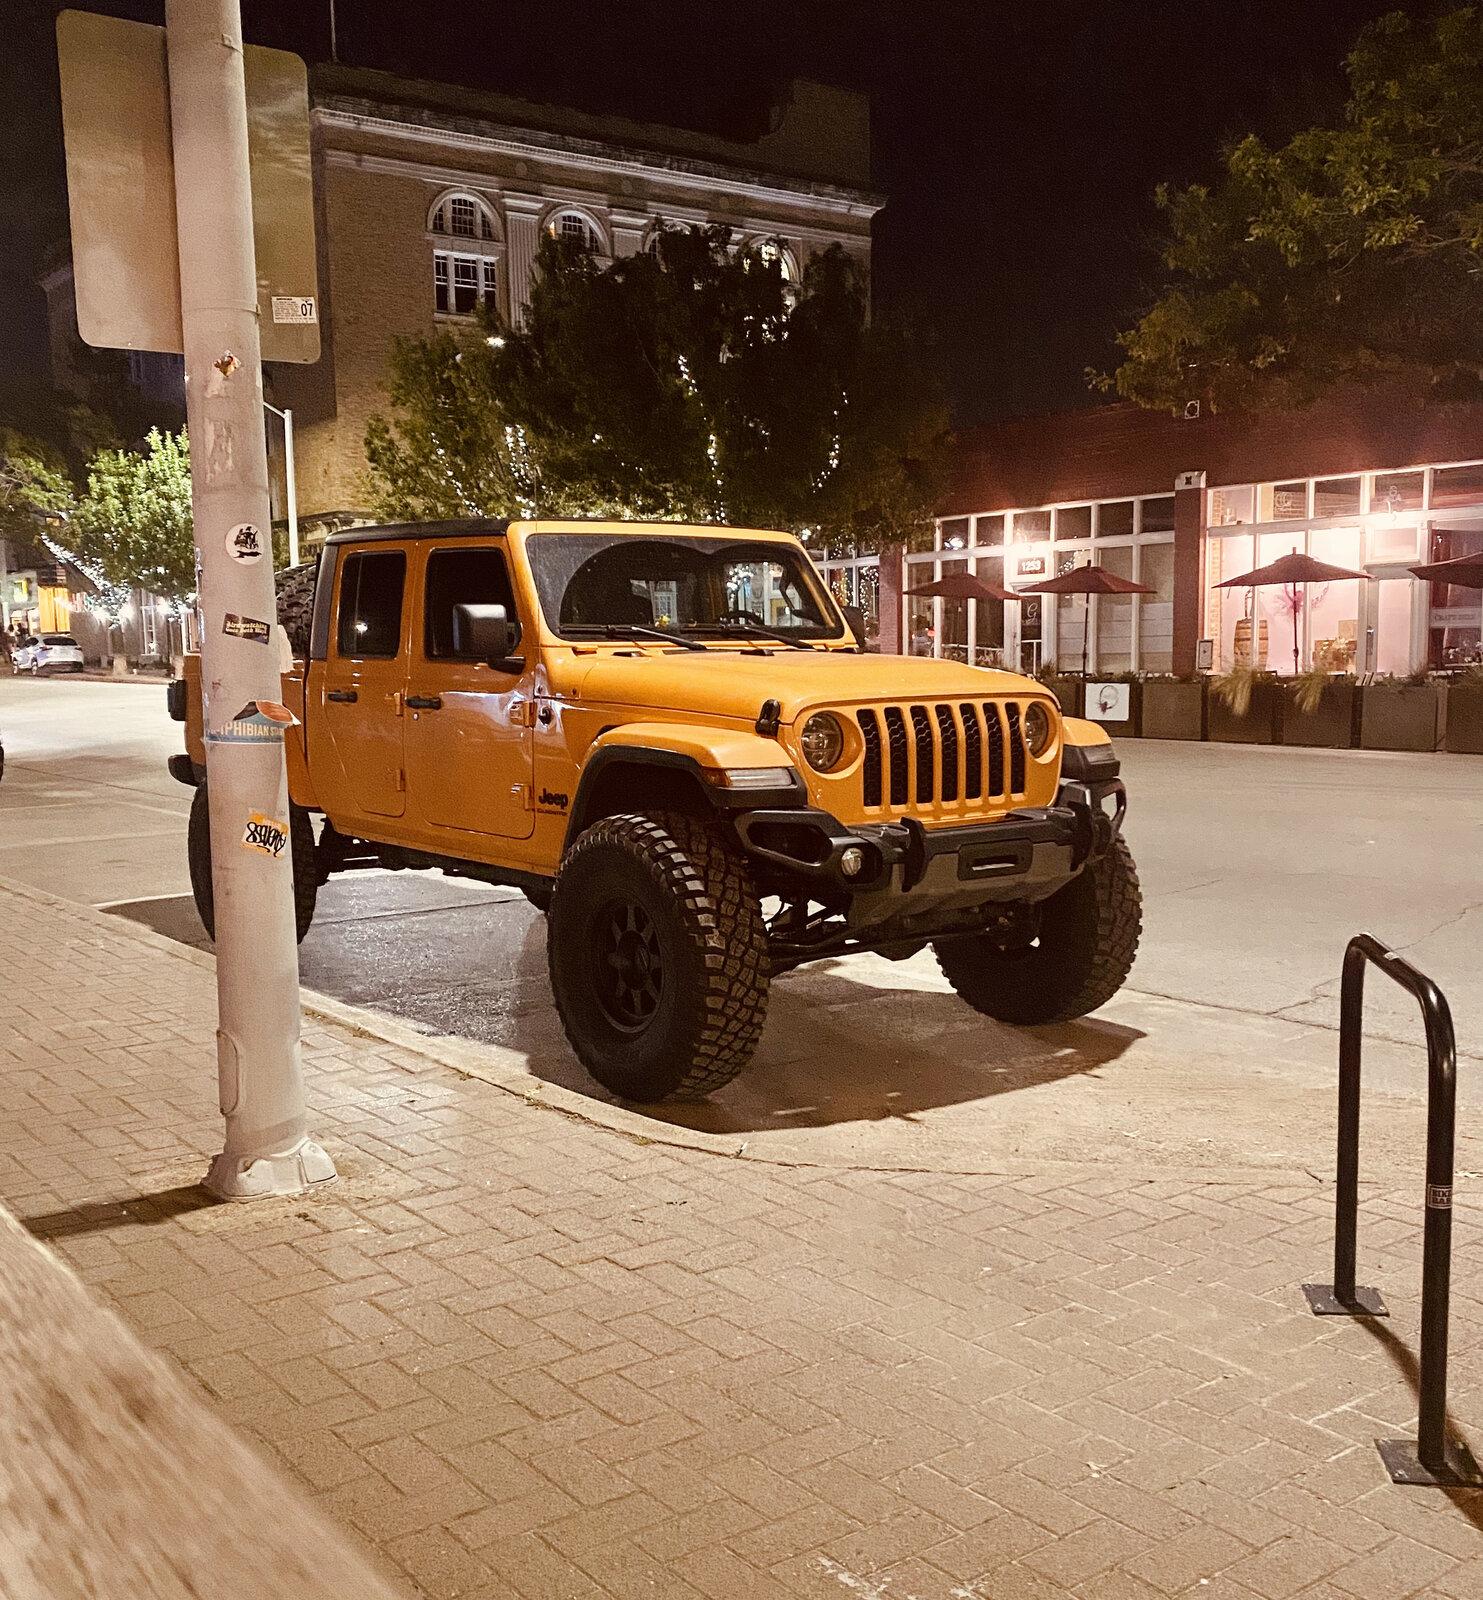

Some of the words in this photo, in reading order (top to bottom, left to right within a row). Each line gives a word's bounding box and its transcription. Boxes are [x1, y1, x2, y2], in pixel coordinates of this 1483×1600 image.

[300, 303, 313, 316] 07
[1021, 560, 1042, 571] 1253
[219, 721, 269, 736] PHIBIAN
[538, 787, 568, 810] Jeep
